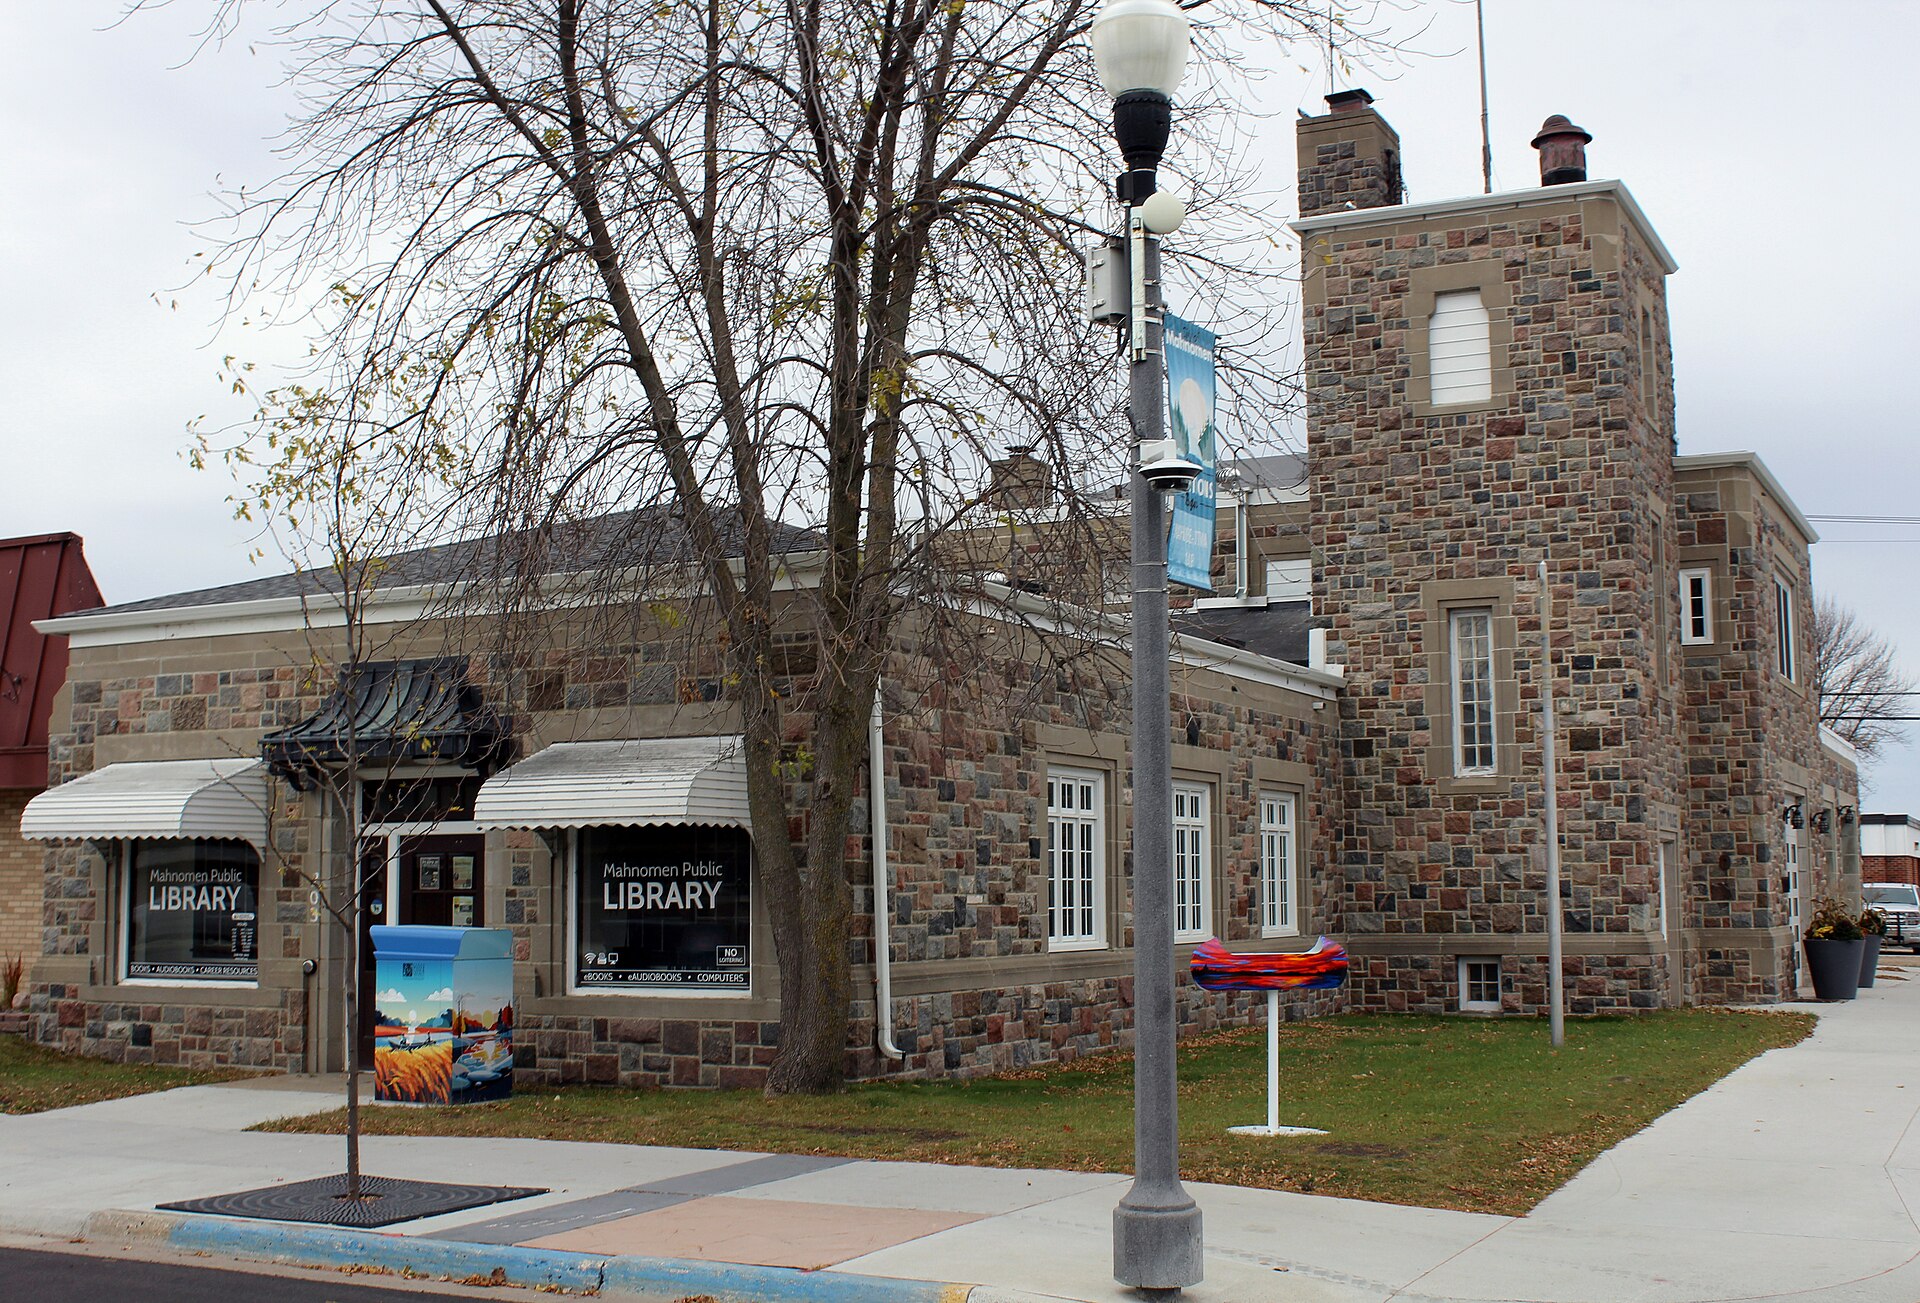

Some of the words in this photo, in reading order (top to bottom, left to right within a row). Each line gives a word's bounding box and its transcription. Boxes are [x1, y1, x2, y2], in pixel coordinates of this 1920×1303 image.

[1166, 328, 1213, 363] Mahnomen
[149, 869, 208, 882] Mahnomen
[211, 868, 242, 882] Public
[603, 862, 678, 878] Mahnomen
[682, 860, 723, 877] Public
[149, 885, 242, 911] LIBRARY
[603, 881, 723, 910] LIBRARY
[724, 948, 738, 957] NO
[130, 965, 151, 973] BOOKS
[156, 965, 195, 974] AUDIOBOOKS
[200, 966, 222, 975] CAREER
[222, 967, 258, 976] RESOURCES
[583, 973, 613, 981] eBOOKS
[627, 973, 682, 982] eAUDIOBOOKS
[697, 973, 744, 982] COMPUTERS
